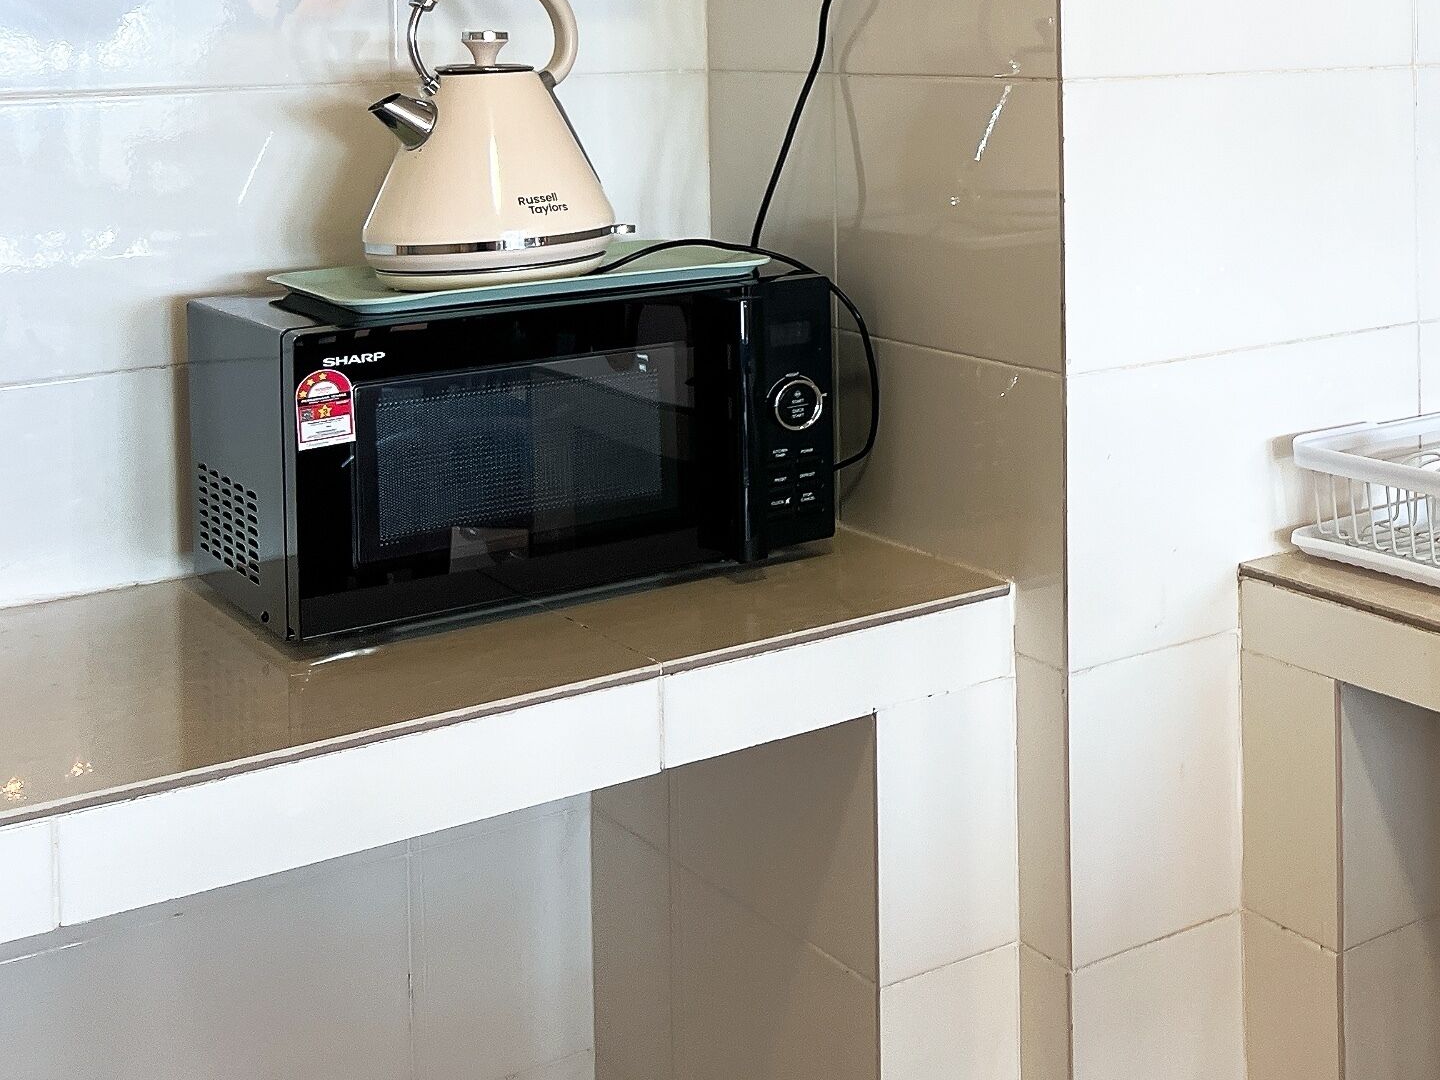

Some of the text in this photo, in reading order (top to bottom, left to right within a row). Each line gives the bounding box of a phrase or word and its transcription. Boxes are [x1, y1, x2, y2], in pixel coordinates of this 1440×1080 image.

[517, 192, 558, 206] Russell
[528, 203, 569, 216] Taylors
[322, 351, 386, 367] SHARP
